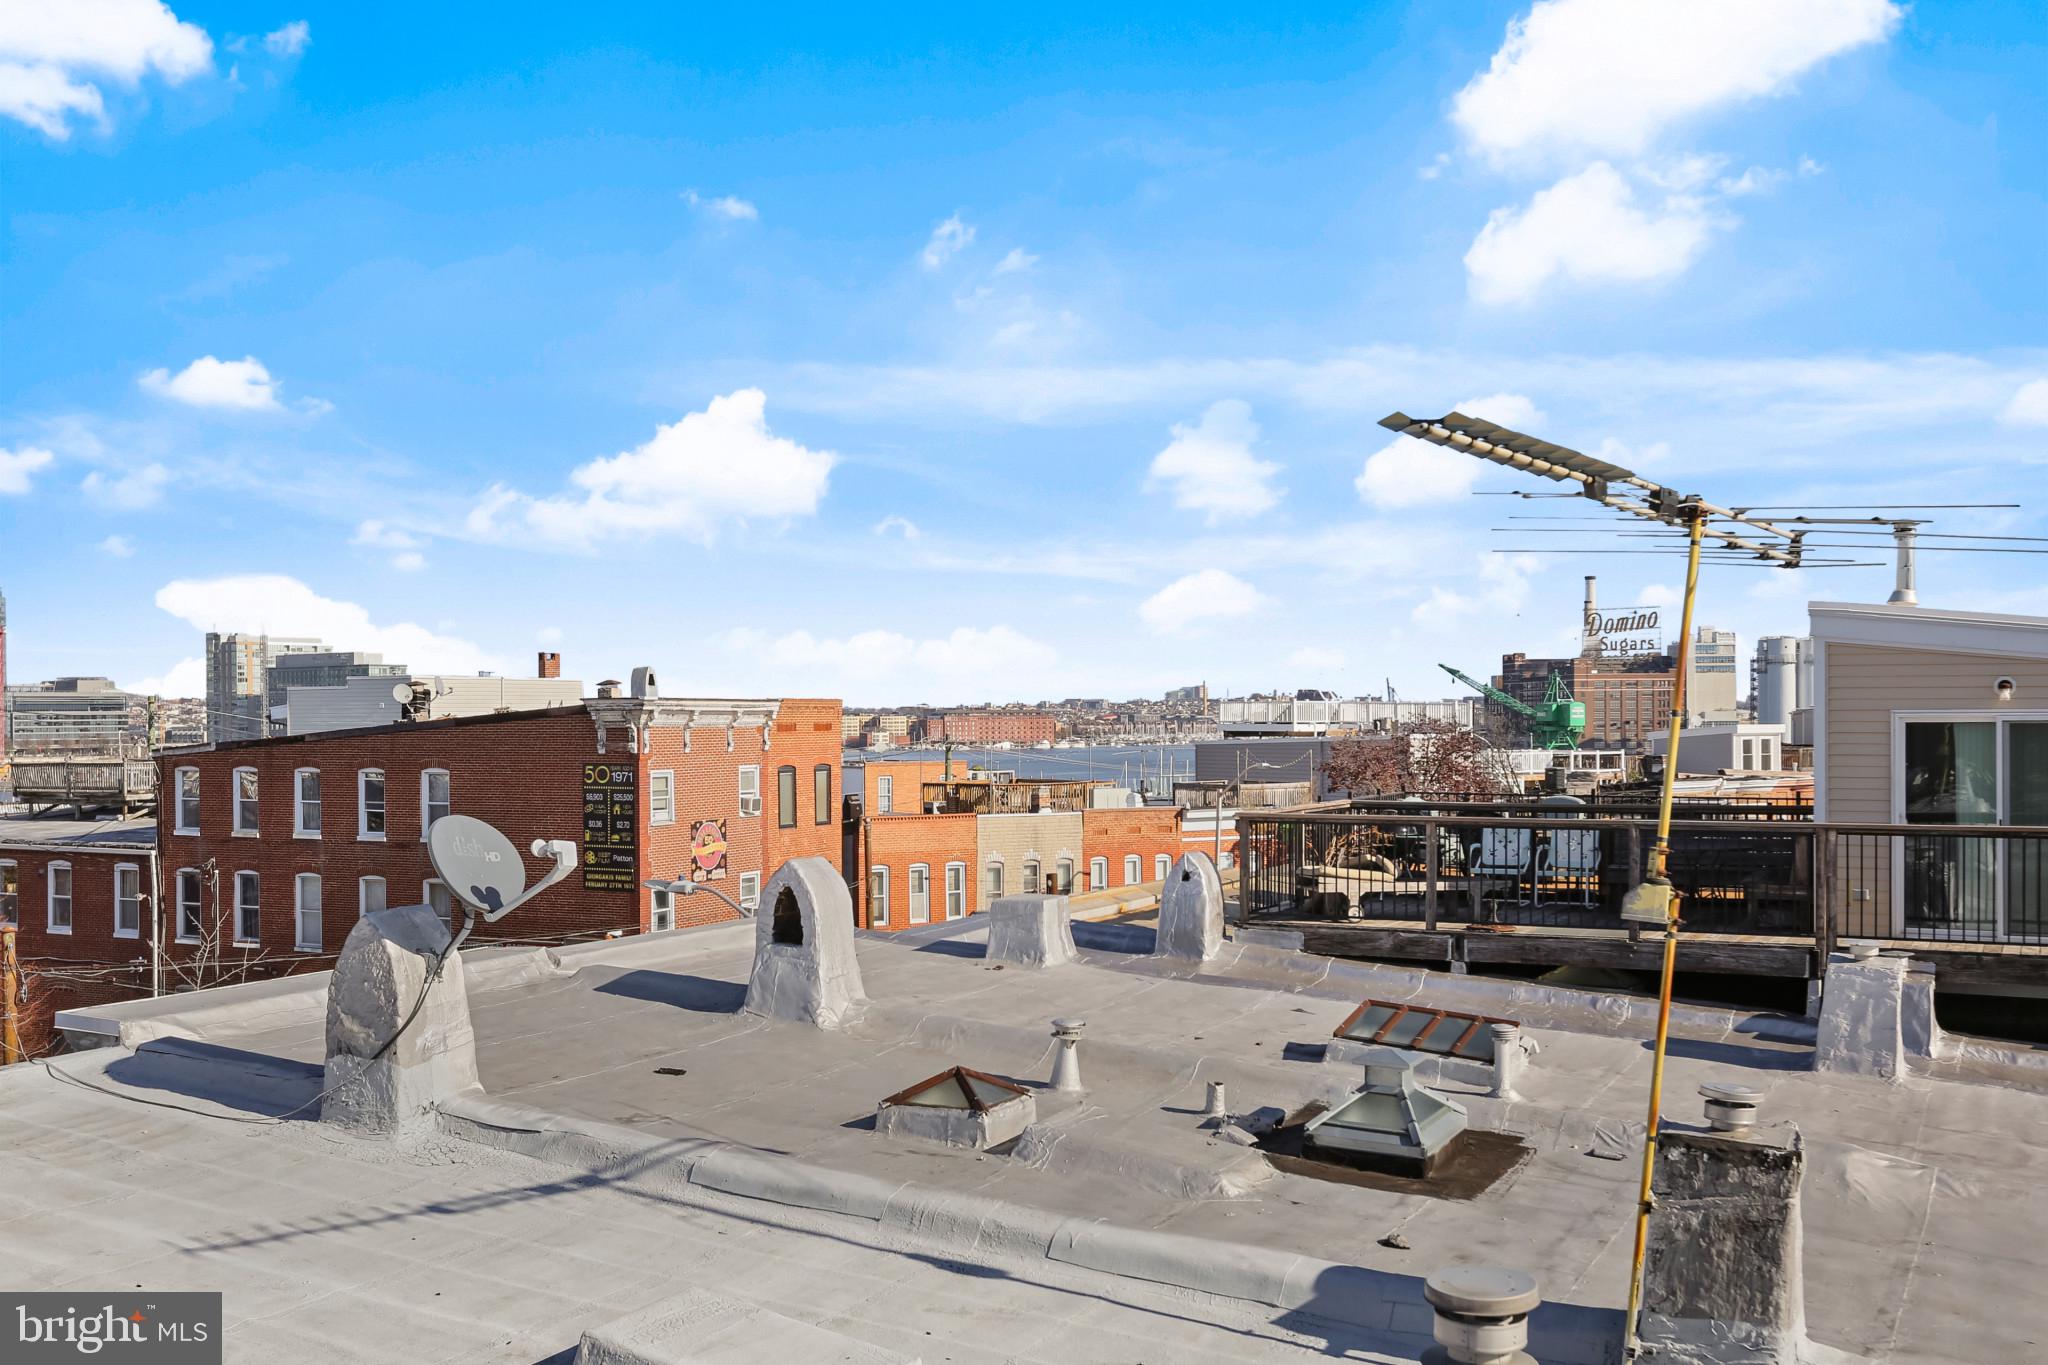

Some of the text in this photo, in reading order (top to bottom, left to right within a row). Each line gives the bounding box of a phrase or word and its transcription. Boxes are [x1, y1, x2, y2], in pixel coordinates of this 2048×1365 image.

[1587, 610, 1658, 637] Domino
[1600, 636, 1655, 656] Sugars
[584, 765, 610, 784] 50
[611, 771, 633, 783] 1971
[484, 850, 501, 863] HD
[612, 854, 634, 862] Patton
